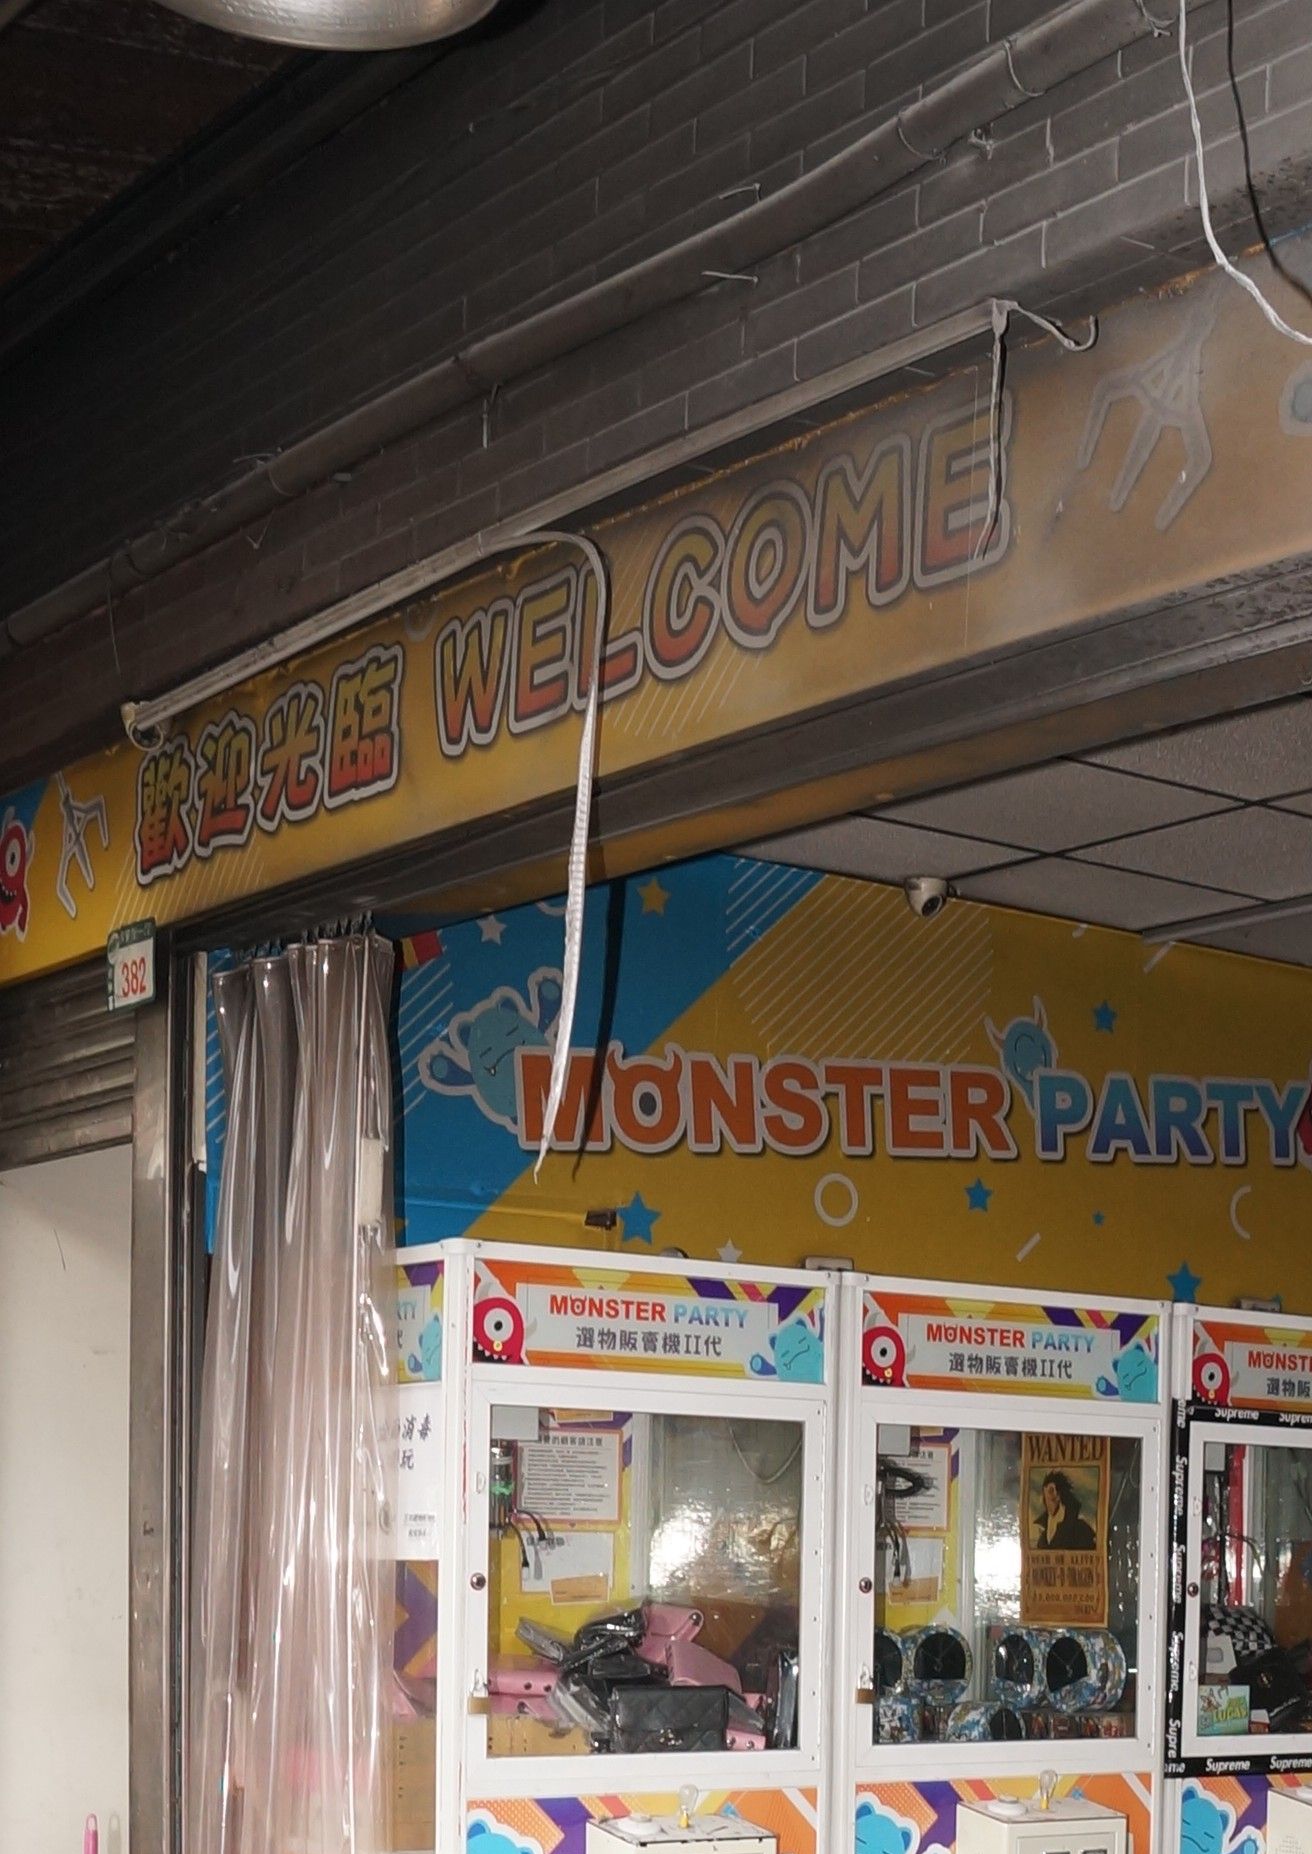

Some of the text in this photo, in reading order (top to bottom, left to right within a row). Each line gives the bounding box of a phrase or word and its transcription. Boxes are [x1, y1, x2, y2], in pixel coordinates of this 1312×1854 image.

[434, 392, 1010, 756] WELCOME
[136, 645, 402, 884] 歡迎光臨
[121, 956, 147, 998] 382
[516, 1046, 1305, 1168] MONSTER PARTY
[548, 1293, 749, 1329] MONSTER PARTY
[926, 1322, 1096, 1354] MONSTER PARTY
[1027, 1435, 1104, 1464] WANTED
[1205, 1759, 1251, 1775] Supreme
